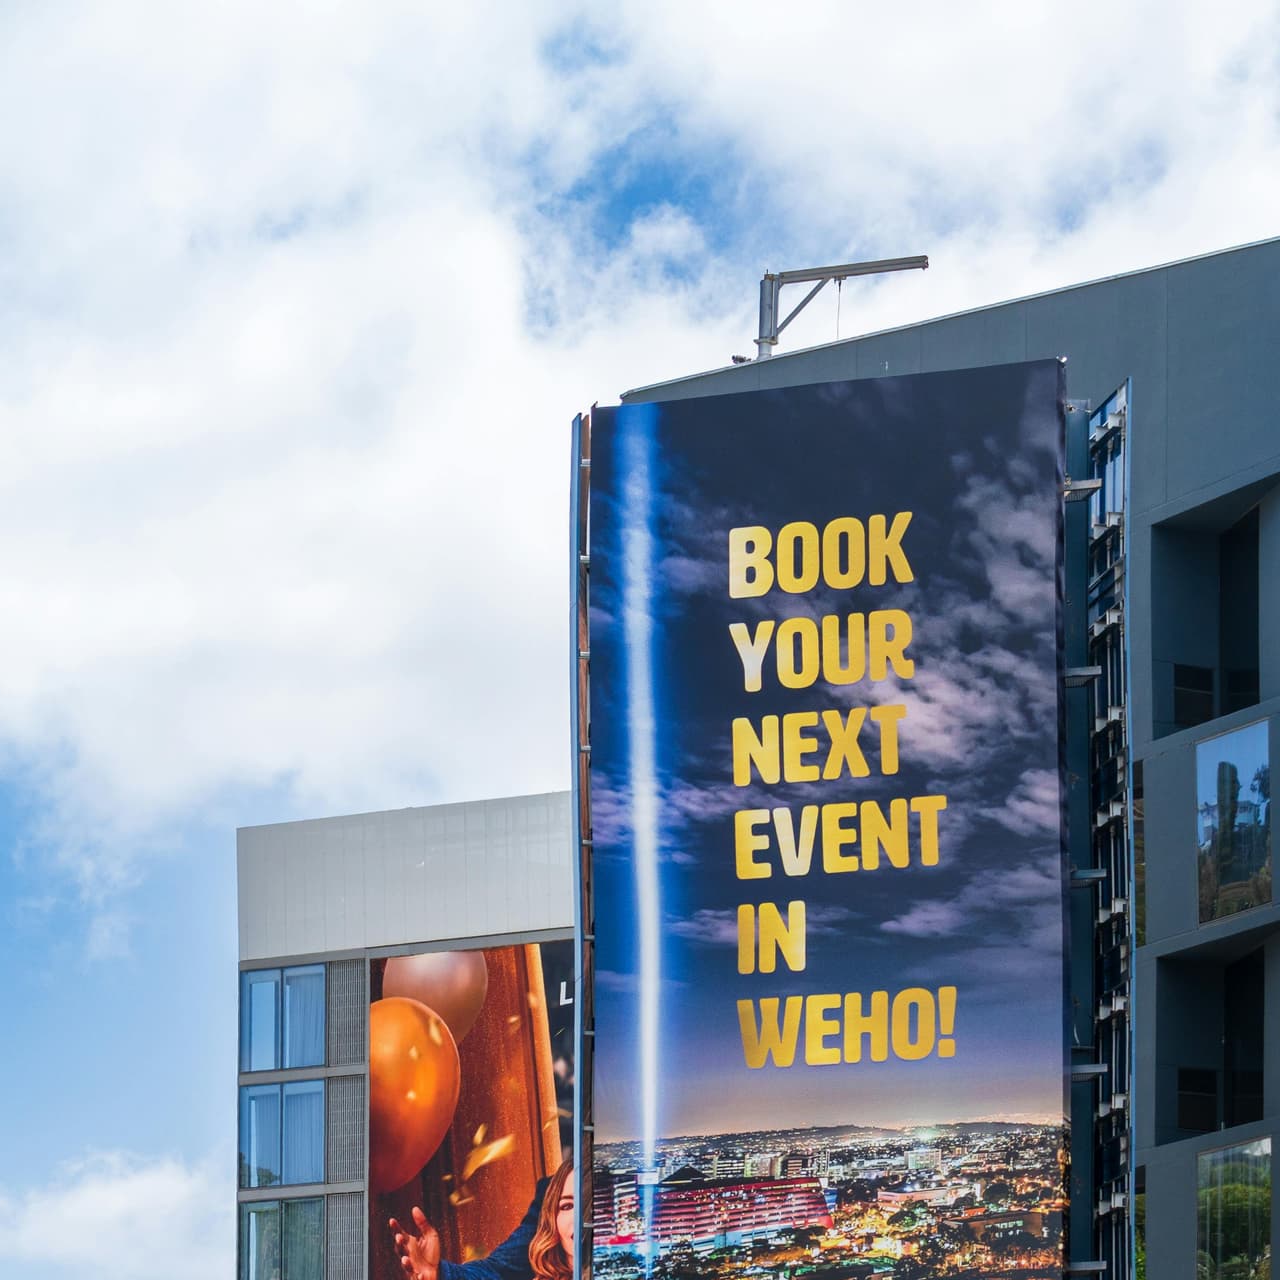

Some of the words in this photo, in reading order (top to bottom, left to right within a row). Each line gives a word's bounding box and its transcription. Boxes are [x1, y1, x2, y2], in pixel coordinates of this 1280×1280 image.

[728, 511, 915, 599] BOOK
[728, 609, 915, 692] YOUR
[731, 704, 907, 787] NEXT
[734, 795, 948, 880] EVENT
[737, 900, 807, 975] IN
[736, 986, 958, 1070] WEHO!
